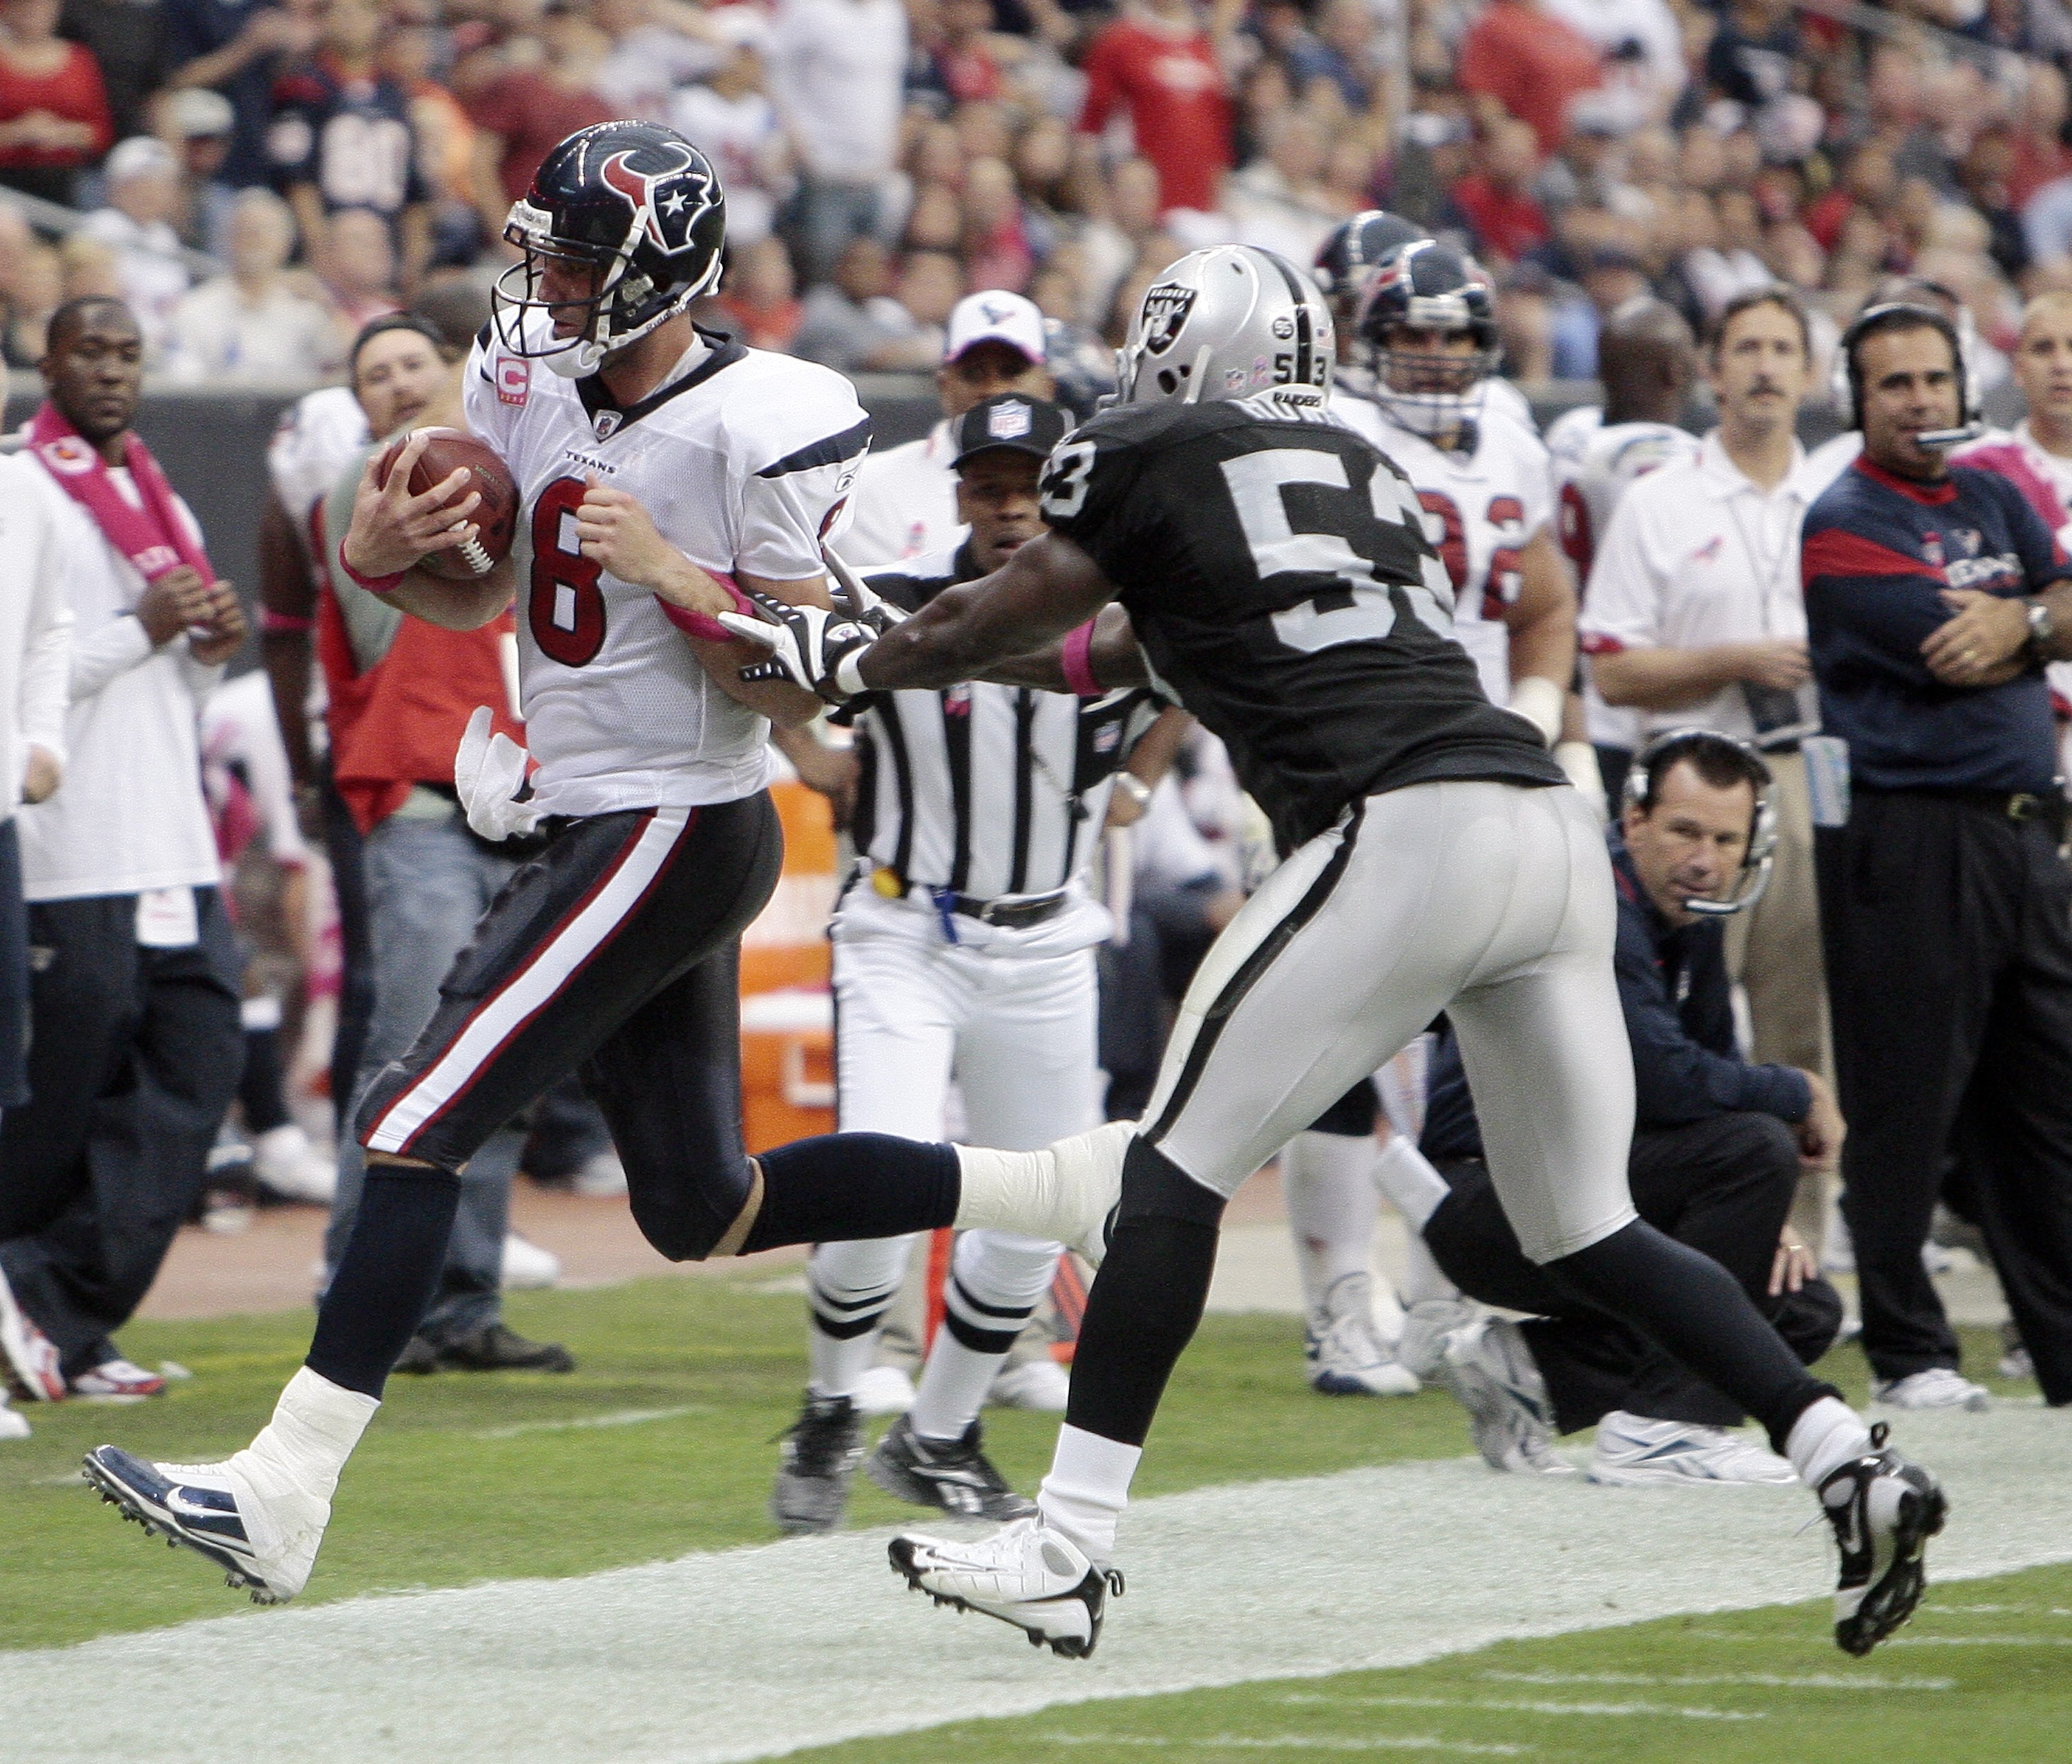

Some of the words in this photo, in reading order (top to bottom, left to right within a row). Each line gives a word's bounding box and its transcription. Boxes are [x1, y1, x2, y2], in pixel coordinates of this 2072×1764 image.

[1150, 289, 1193, 298] RAIDERS
[499, 361, 527, 395] C
[1274, 392, 1322, 407] RAIDERS
[565, 450, 617, 474] TEXANS
[1219, 448, 1457, 653] 53
[528, 475, 607, 668] 8
